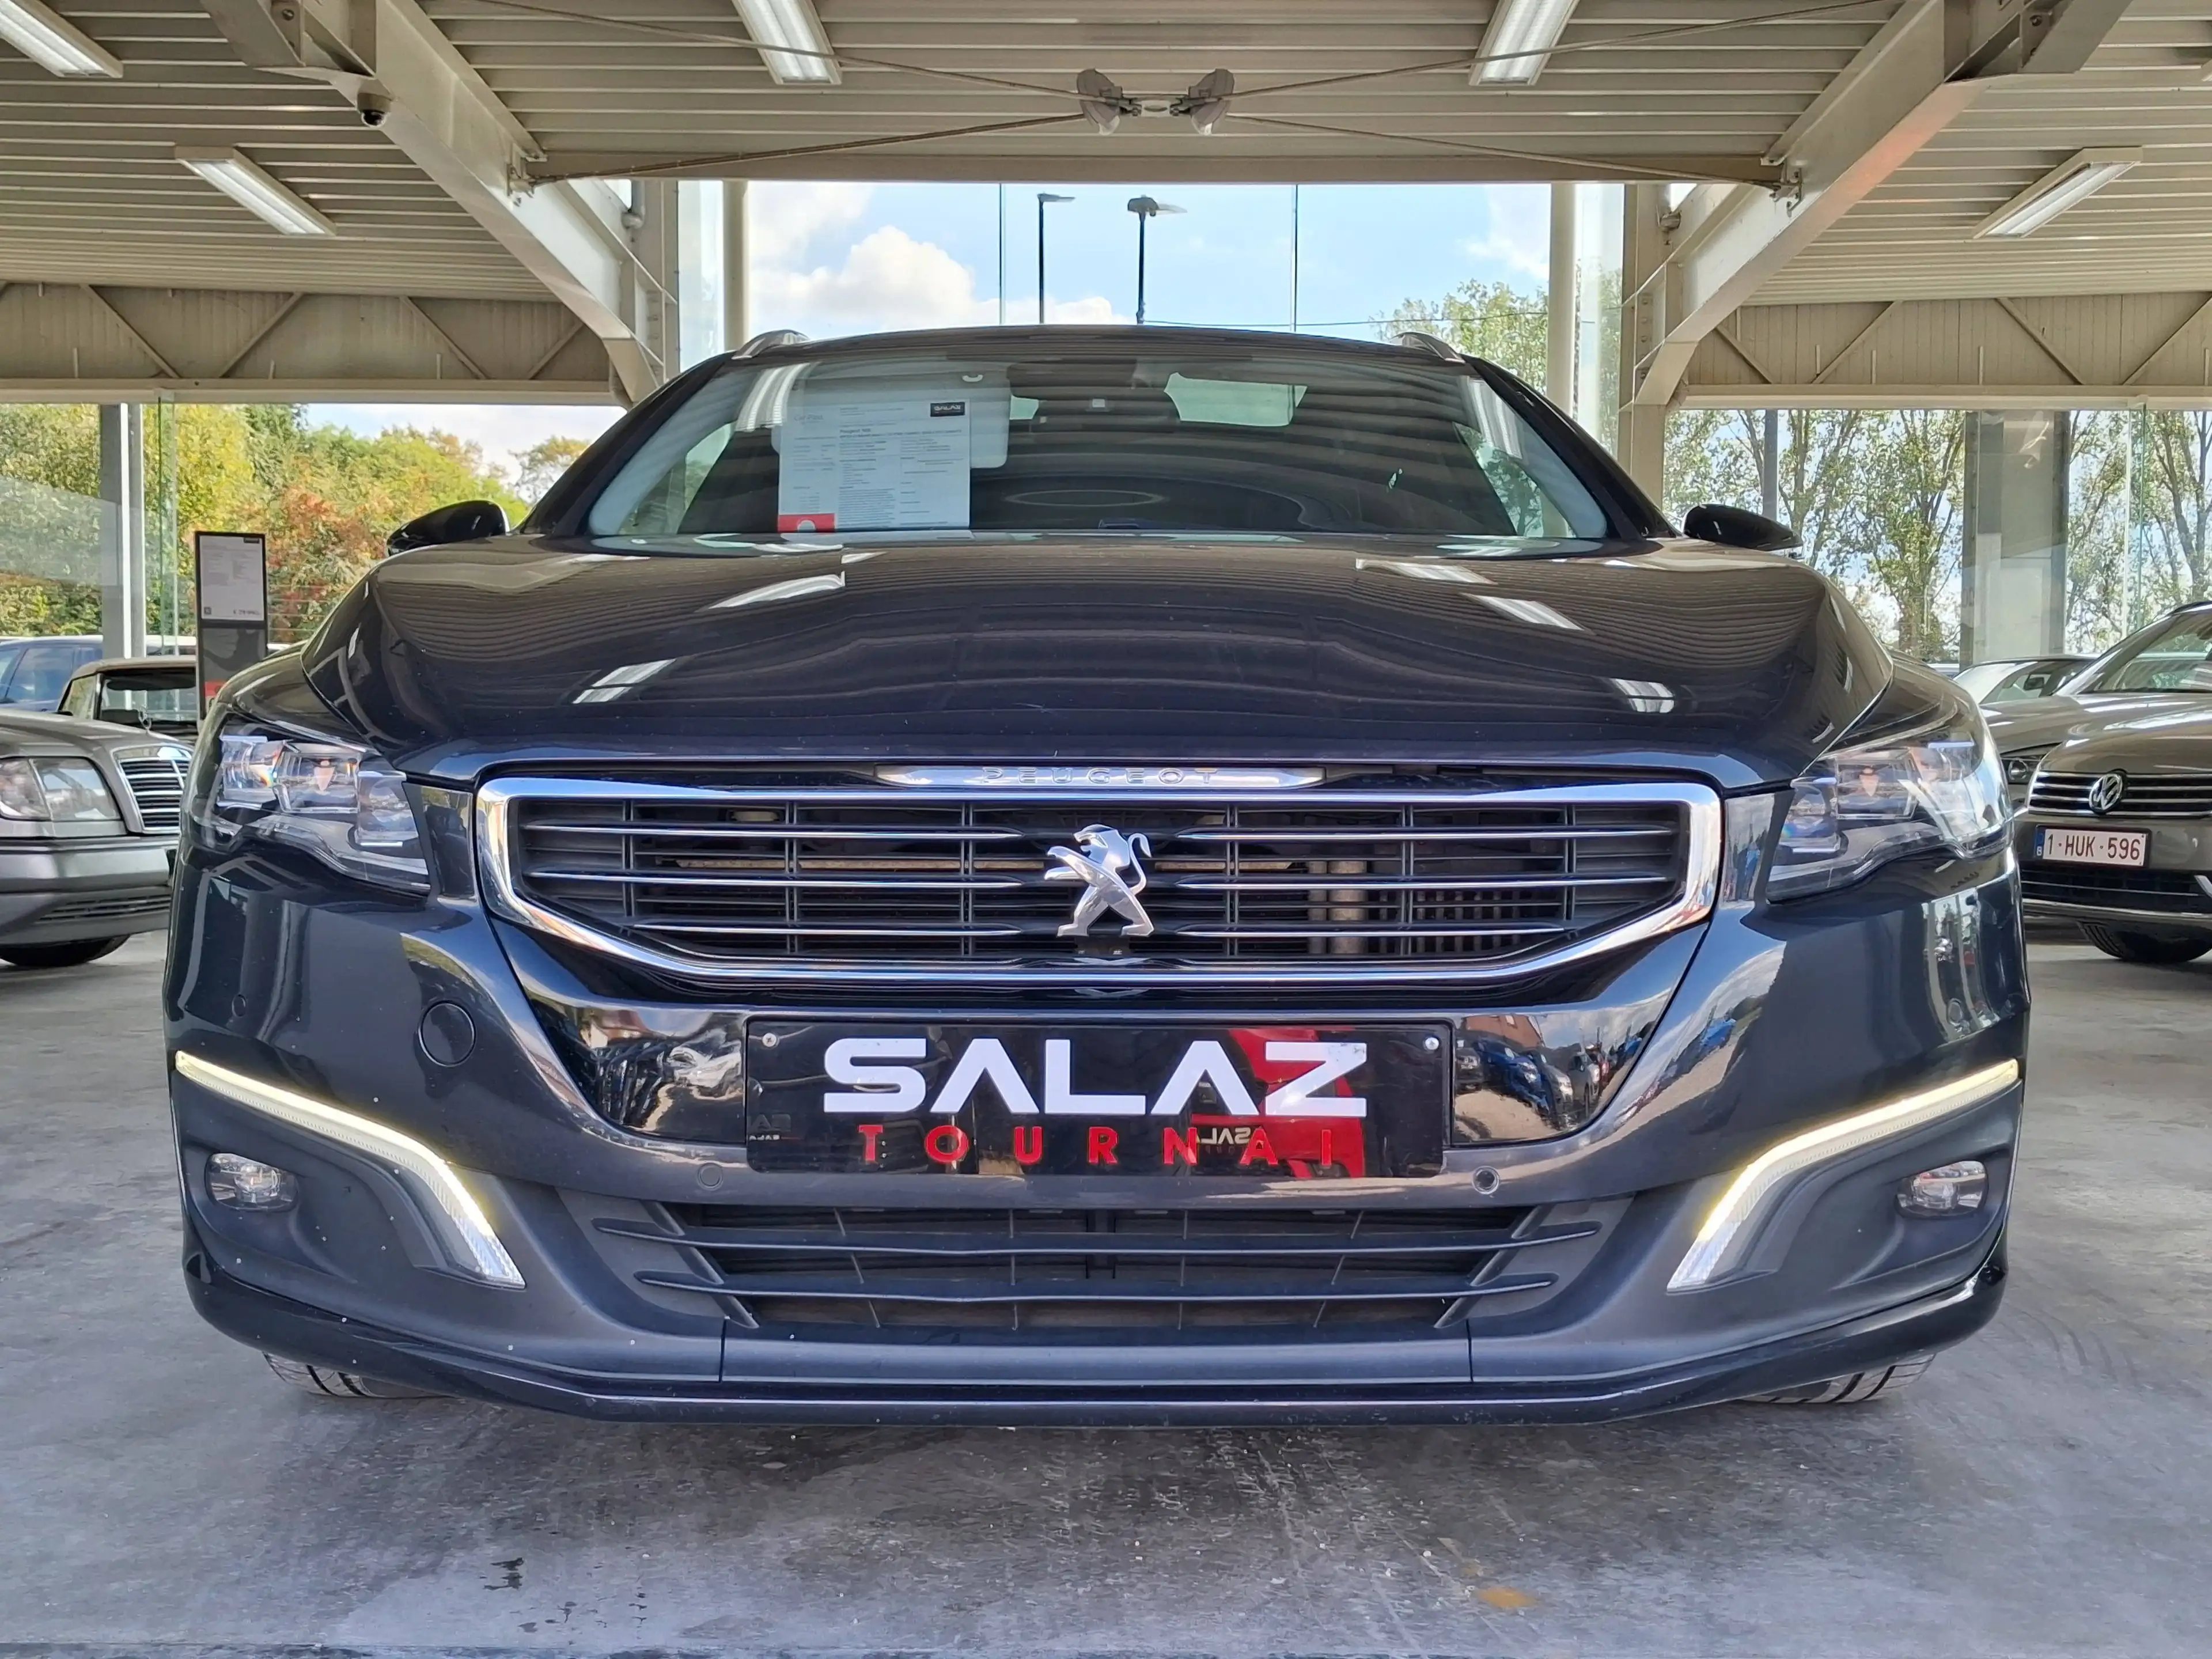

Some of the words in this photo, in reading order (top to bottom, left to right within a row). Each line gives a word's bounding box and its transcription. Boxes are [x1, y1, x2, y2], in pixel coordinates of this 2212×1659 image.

[980, 767, 1219, 785] PEUGEOT
[824, 1037, 1367, 1117] SALAZ
[857, 1124, 1332, 1166] TOURNAI
